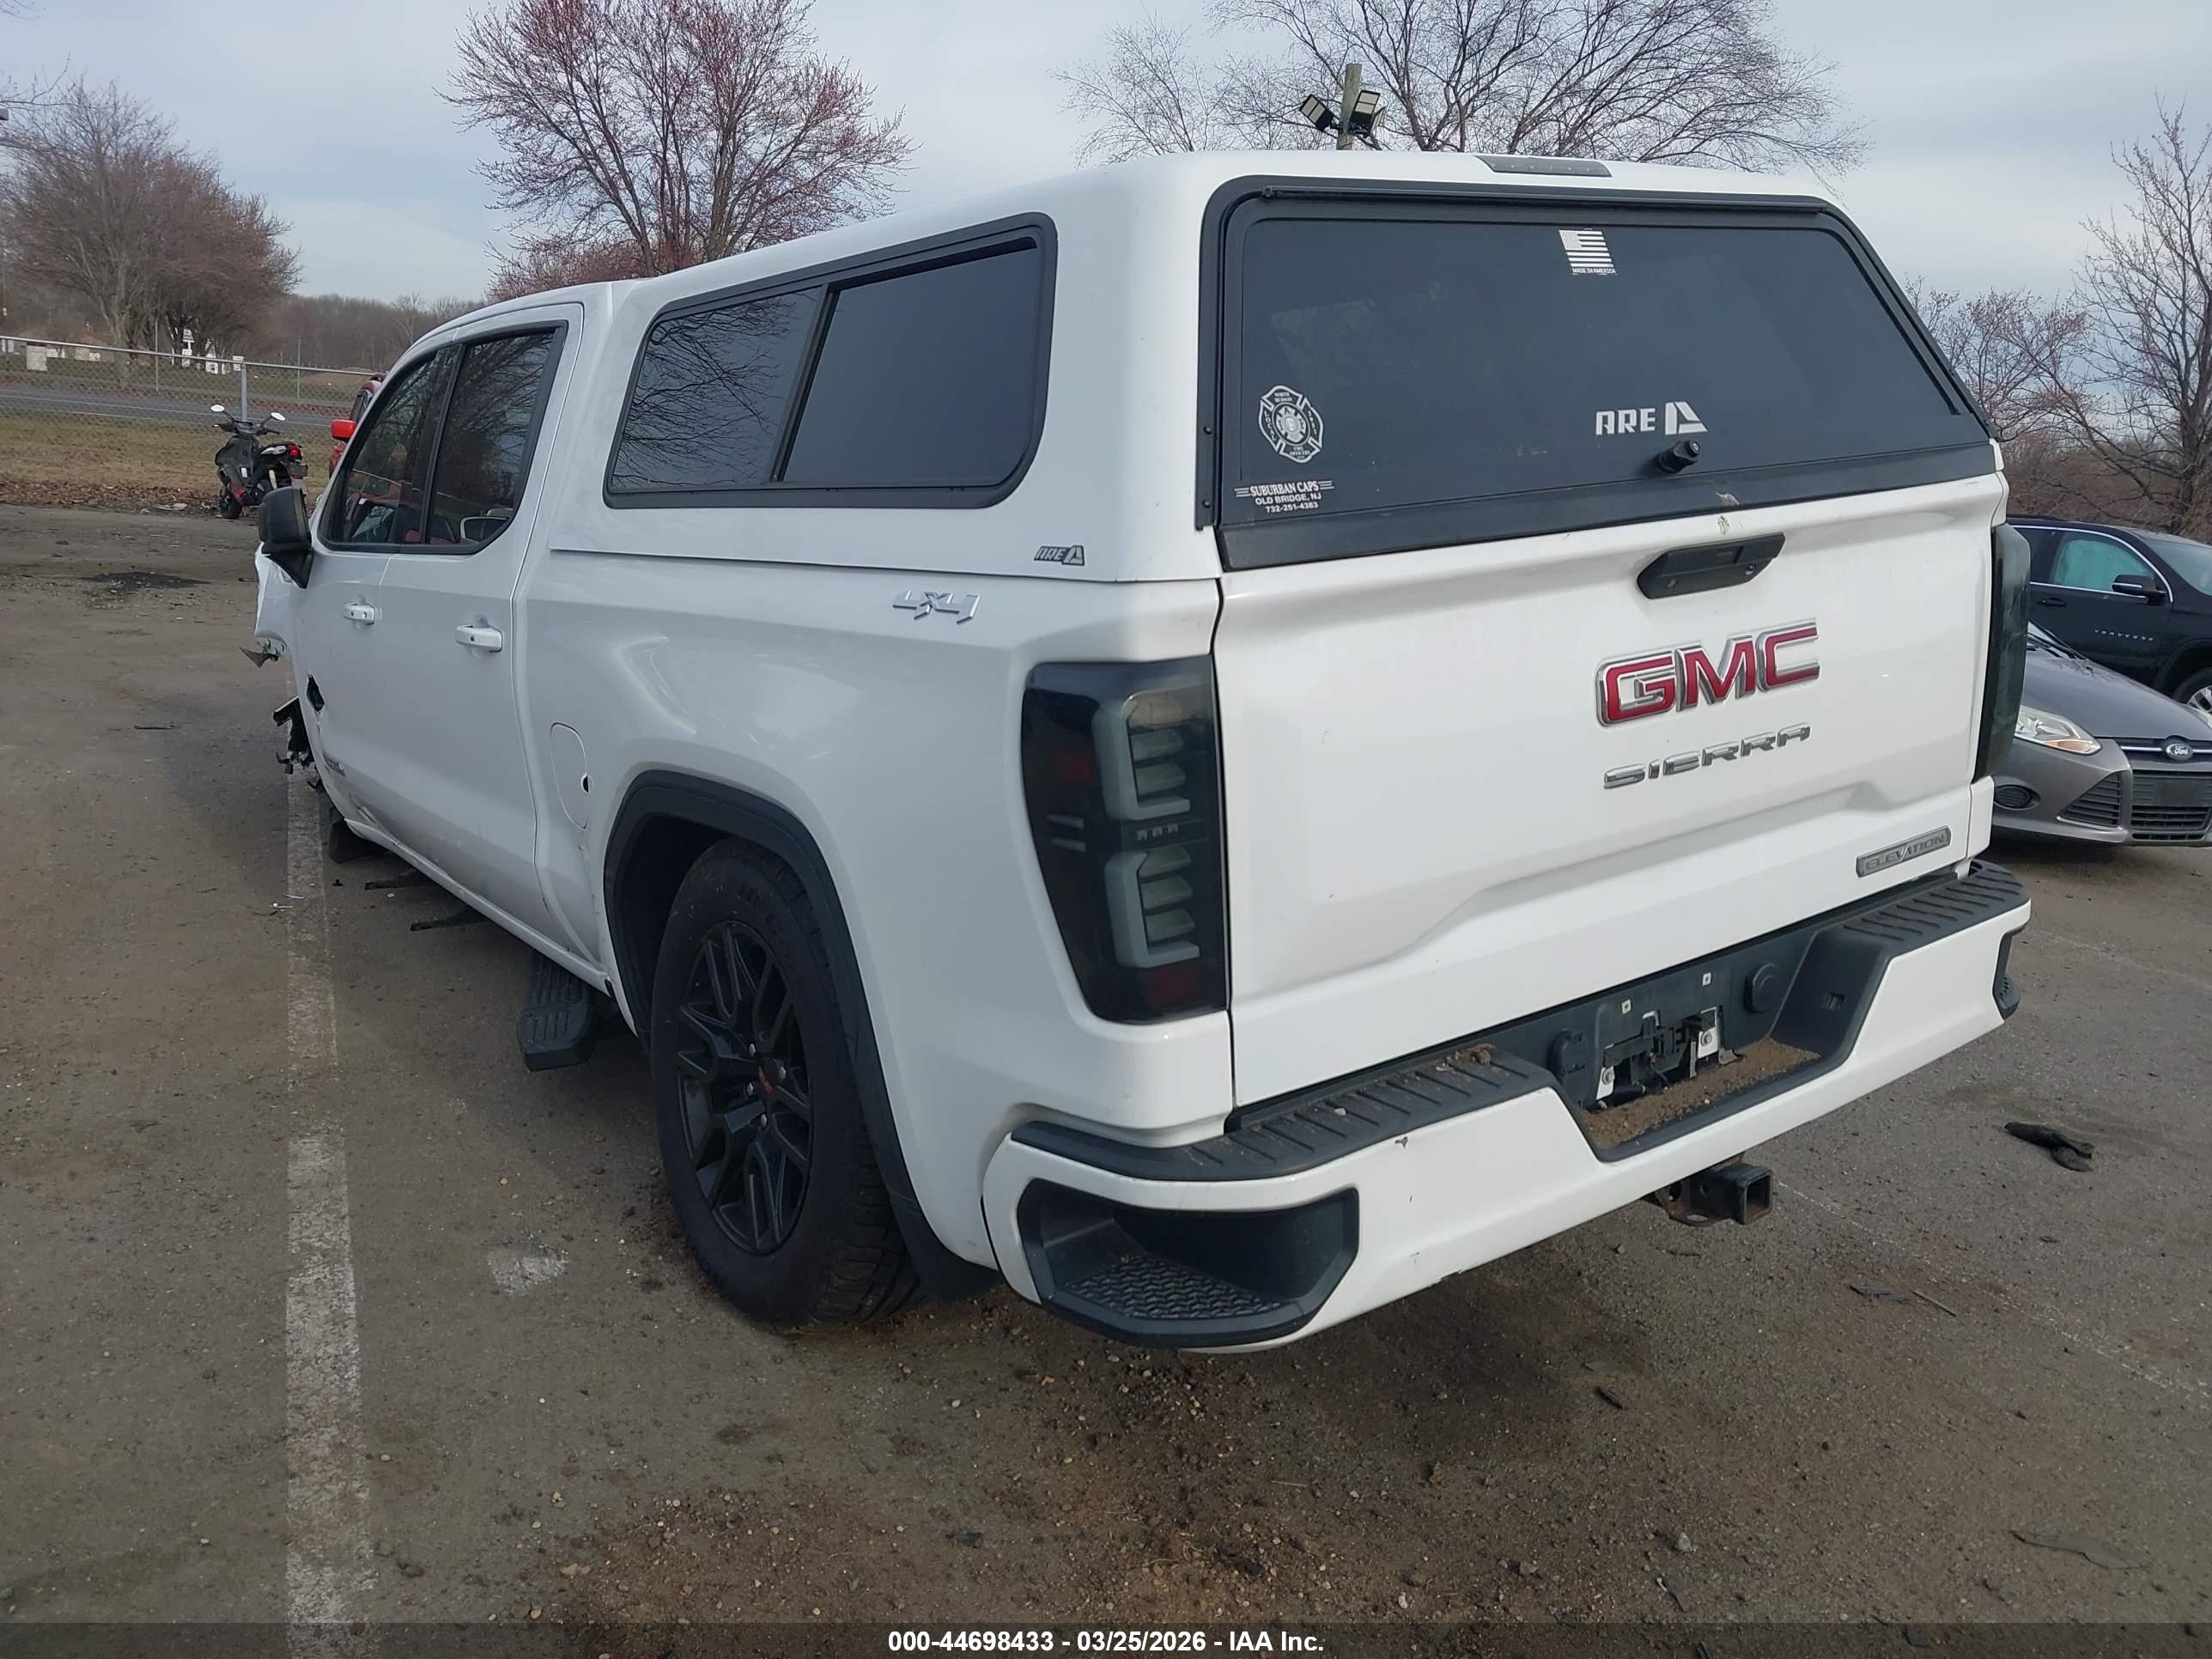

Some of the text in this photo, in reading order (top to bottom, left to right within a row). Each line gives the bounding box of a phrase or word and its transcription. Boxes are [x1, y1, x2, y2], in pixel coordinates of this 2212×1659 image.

[1595, 408, 1656, 435] ARE
[1249, 480, 1319, 497] SUBURBAN CAPS
[1255, 492, 1322, 506] OLD BRIDGE, NJ
[1035, 548, 1066, 560] ARE
[1595, 618, 1820, 728] GMC
[1603, 723, 1812, 790] SIERRA
[1866, 833, 1945, 870] ELEVATION
